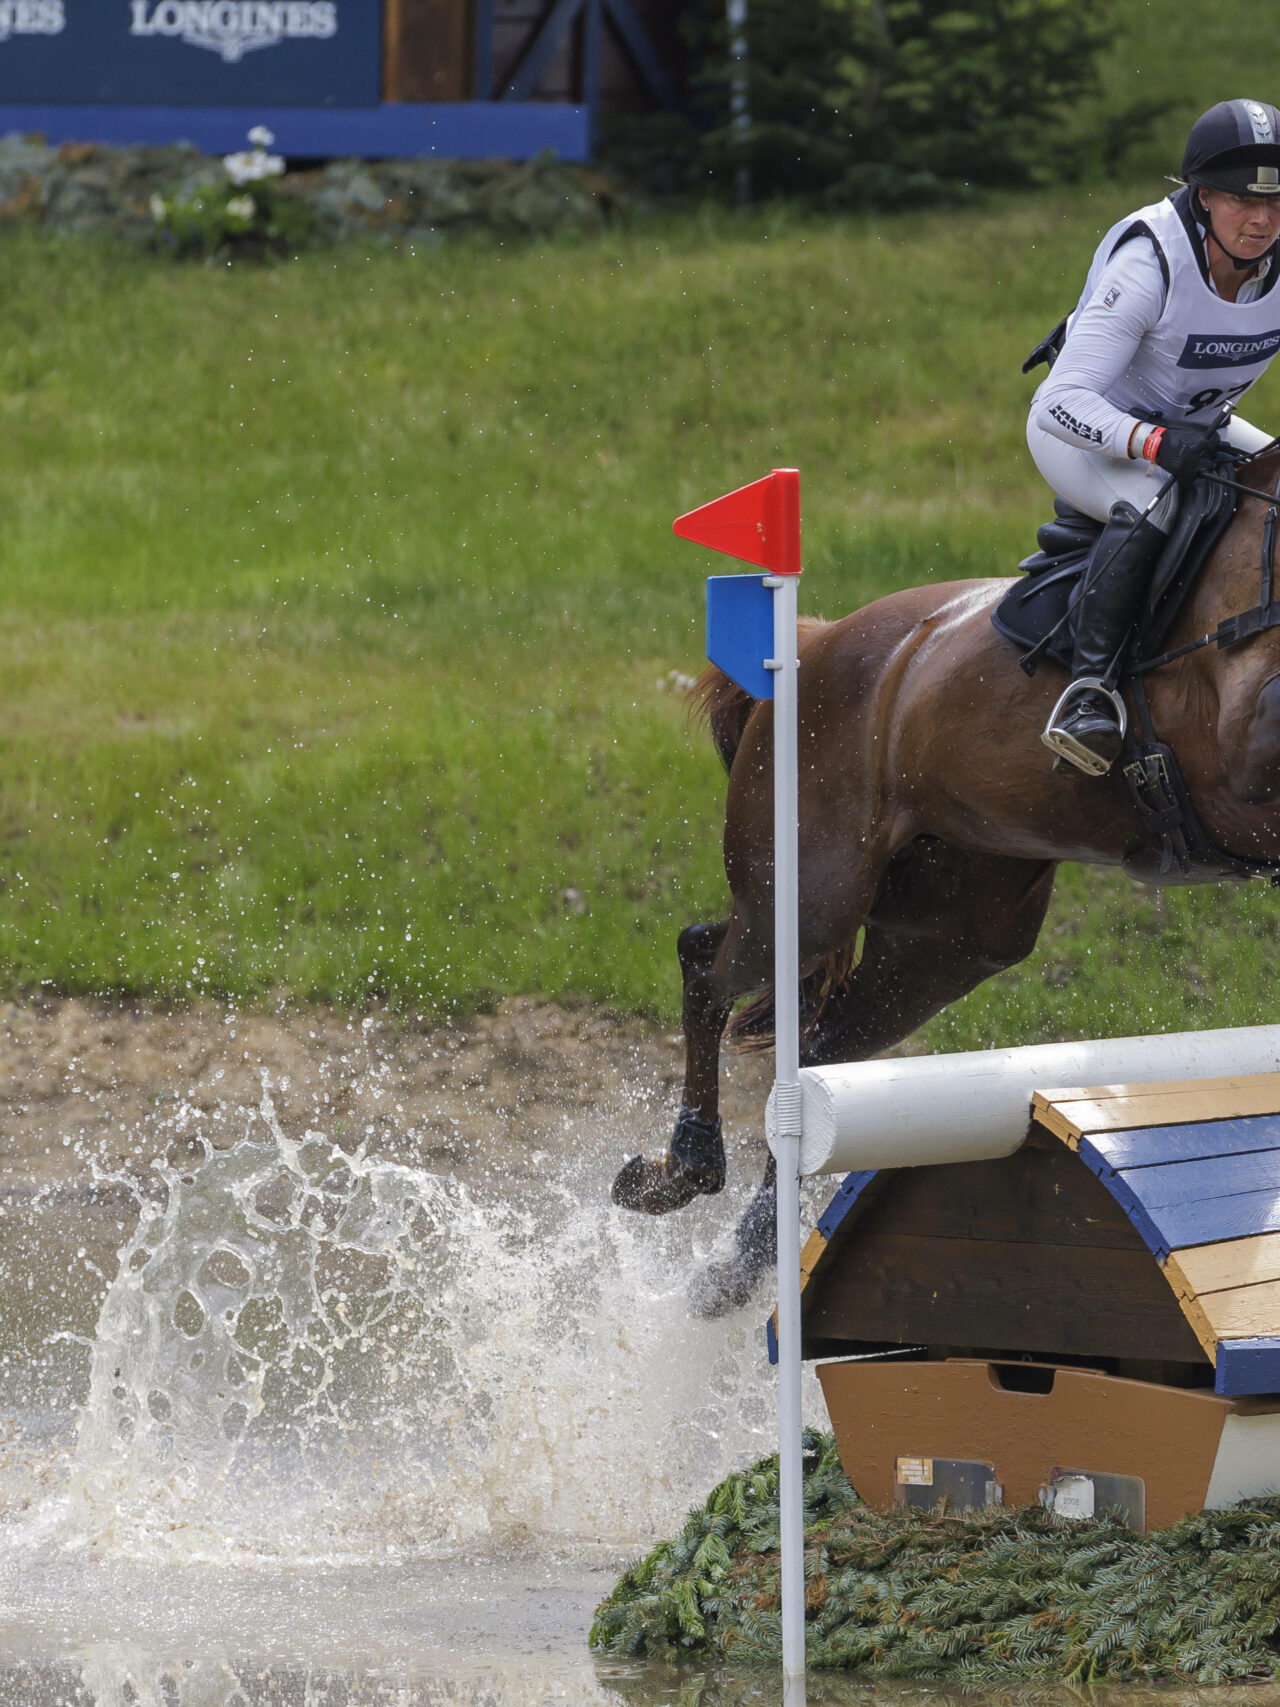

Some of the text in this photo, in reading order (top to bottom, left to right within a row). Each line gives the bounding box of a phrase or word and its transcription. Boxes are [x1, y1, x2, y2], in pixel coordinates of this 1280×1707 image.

[130, 0, 337, 39] LONGINES
[1193, 335, 1280, 355] LONGINES
[1048, 405, 1103, 445] FENDT
